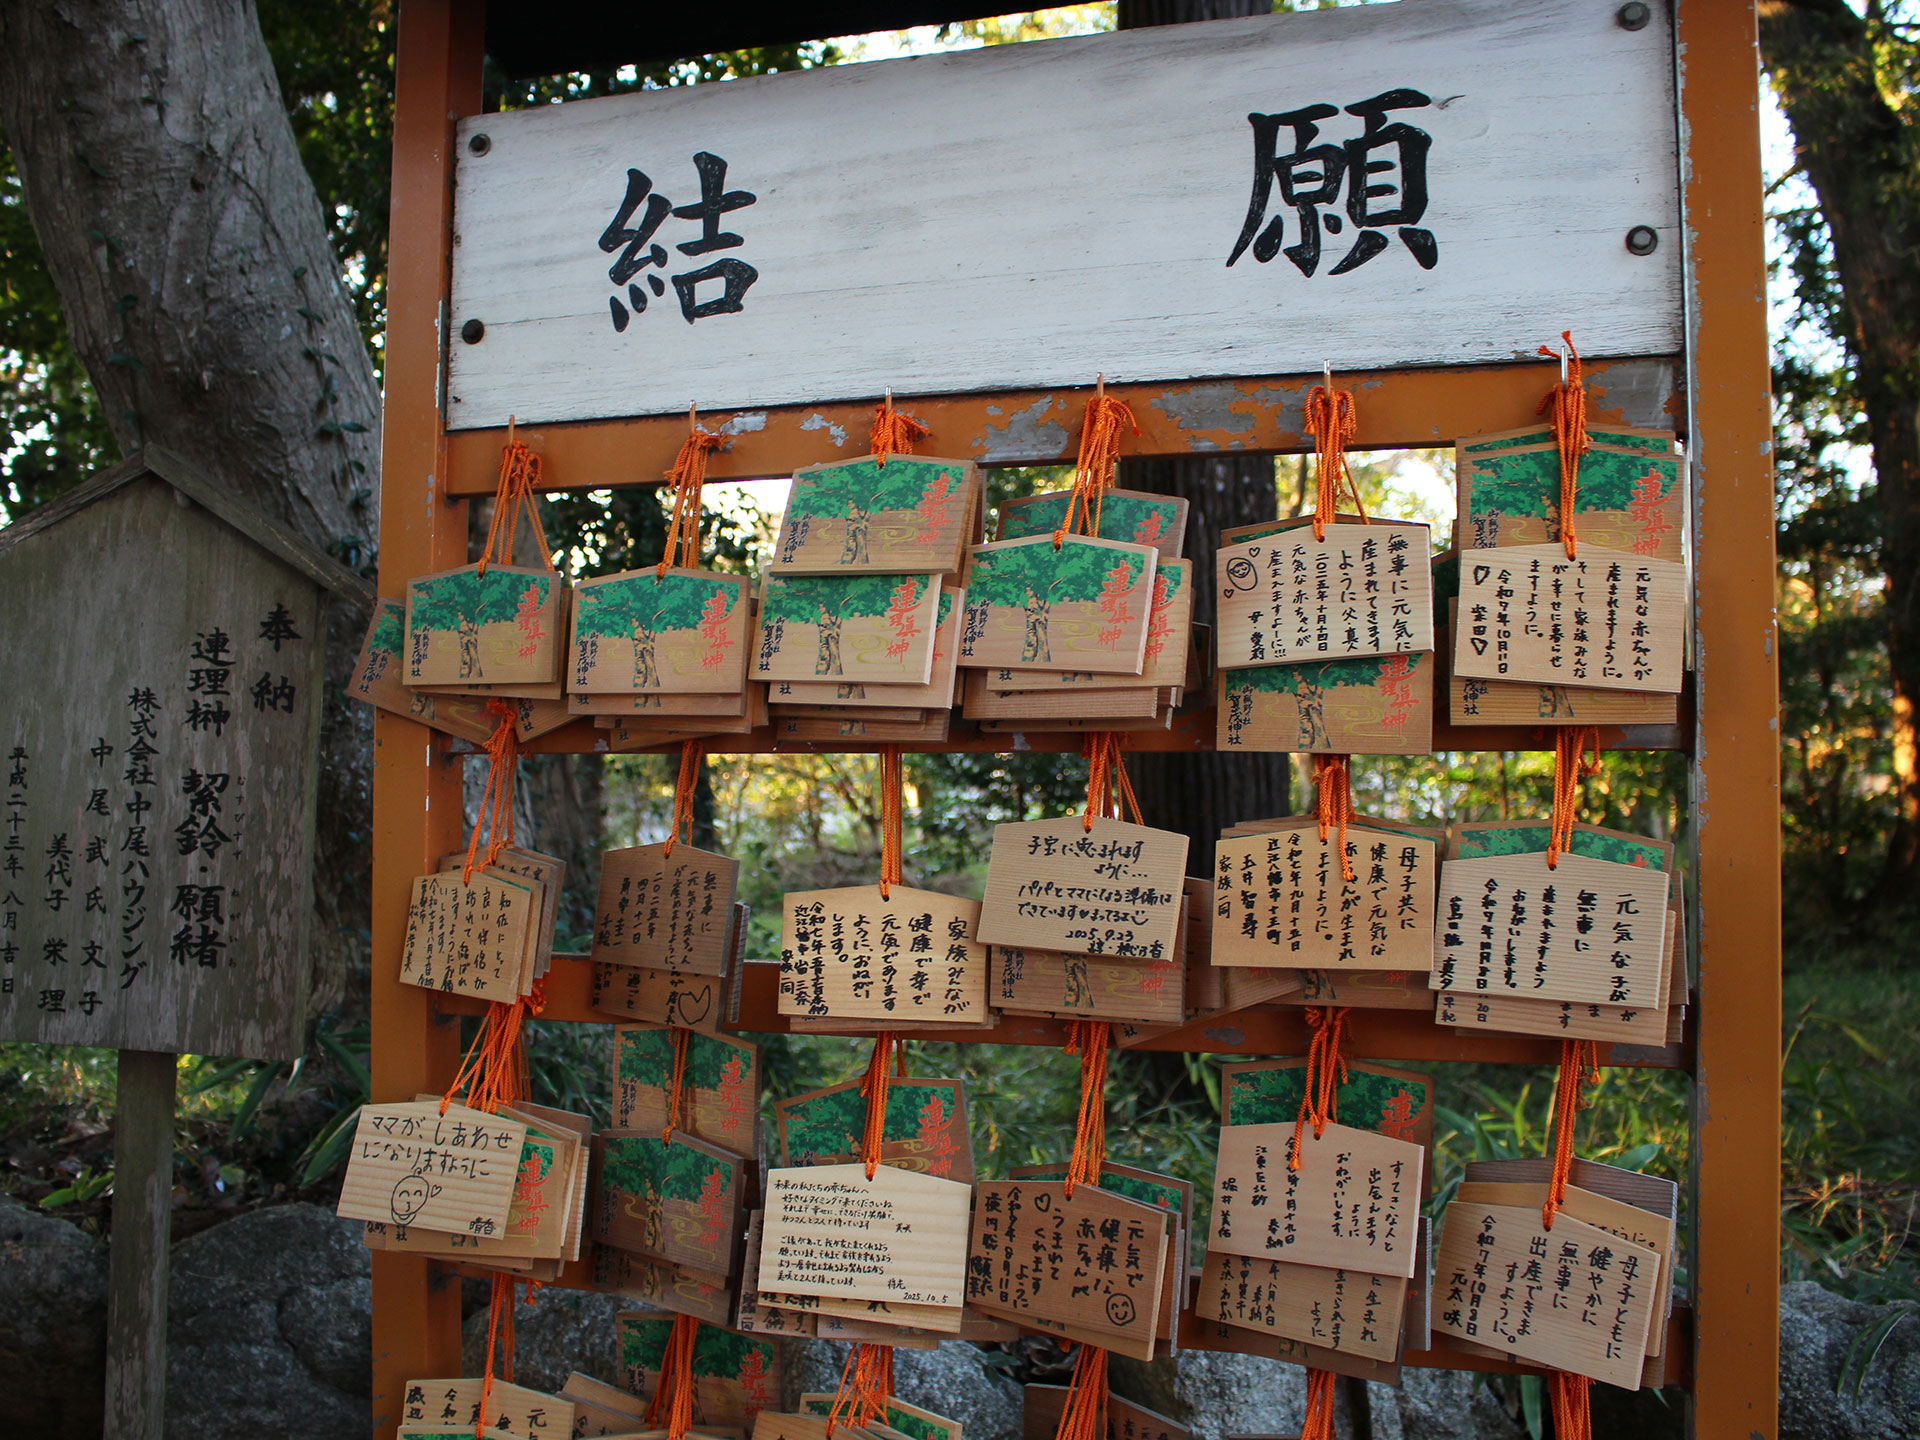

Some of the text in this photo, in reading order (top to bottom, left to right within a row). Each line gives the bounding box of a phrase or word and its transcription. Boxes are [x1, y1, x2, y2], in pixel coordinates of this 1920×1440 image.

[597, 88, 1435, 333] 結 願
[1291, 543, 1312, 648] 元気な赤ちゃんが
[1360, 538, 1381, 652] 産まれてきます
[1387, 533, 1415, 652] 無事に元気に
[1549, 563, 1570, 669] が幸せに暮らせ
[1572, 560, 1590, 679] そして家族みんな
[1631, 566, 1654, 681] 元気な赤ちゃんが
[250, 603, 302, 714] 奉納
[119, 686, 162, 990] 株式会社中尾ハウジング
[1217, 854, 1233, 919] 家族一同
[1397, 846, 1421, 930] 母子共に
[700, 871, 718, 934] 無事に
[1018, 880, 1173, 907] パパとママになる準備は
[1533, 884, 1557, 990] 産まれますよう
[1574, 888, 1598, 952] 無事に
[943, 916, 971, 1015] 家族みんなが
[1609, 893, 1641, 1003] 元気な子が
[362, 1141, 490, 1180] になりますように
[371, 1115, 513, 1150] ママが、しあわせ
[1125, 1218, 1145, 1288] 元気で
[1348, 1203, 1361, 1239] ように
[1516, 1235, 1549, 1337] 出産できま
[1552, 1240, 1580, 1310] 無事に
[1582, 1244, 1615, 1327] 健やかに
[1605, 1254, 1641, 1360] 母子ともに
